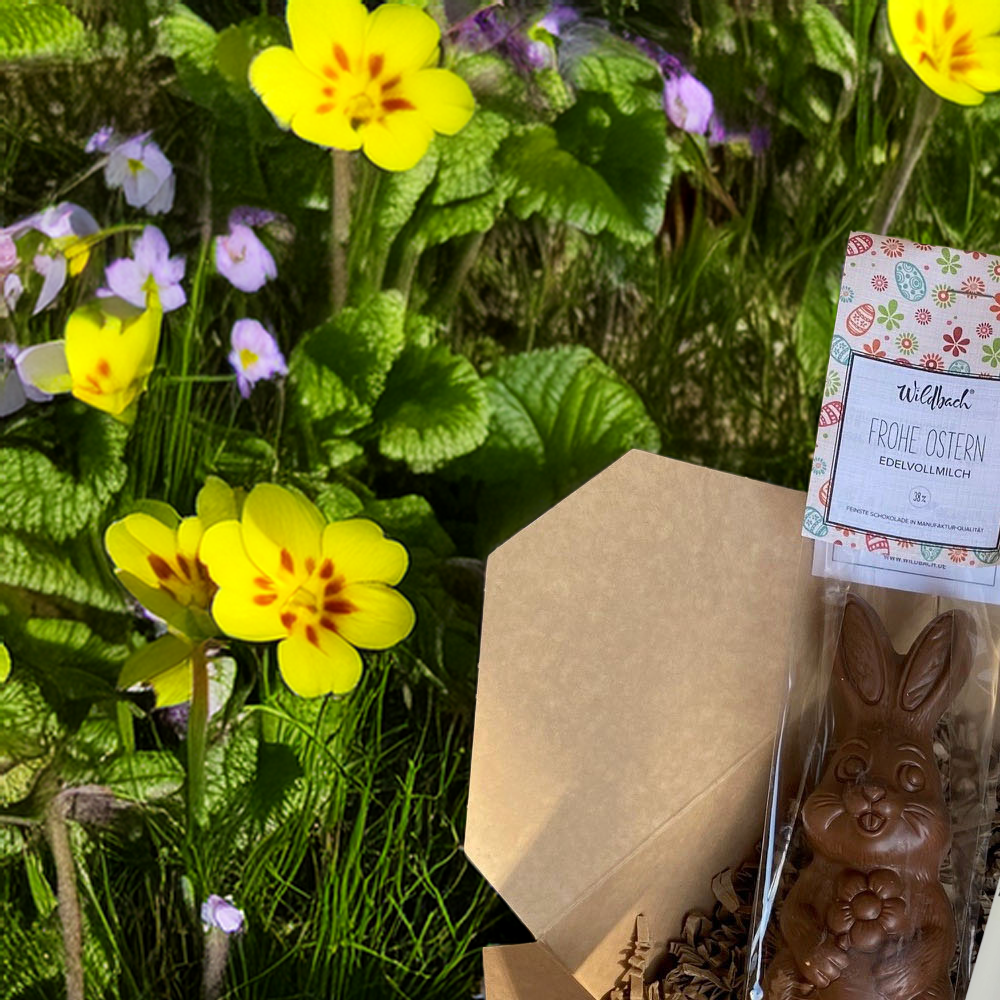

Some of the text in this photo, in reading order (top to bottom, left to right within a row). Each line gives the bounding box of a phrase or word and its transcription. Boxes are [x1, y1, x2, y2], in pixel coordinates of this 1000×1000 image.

[868, 417, 987, 462] FROHE OSTERN
[879, 456, 971, 479] EDELVOLLMILCH
[846, 505, 869, 516] FEINSTE
[870, 511, 909, 525] SCHOKOLADE
